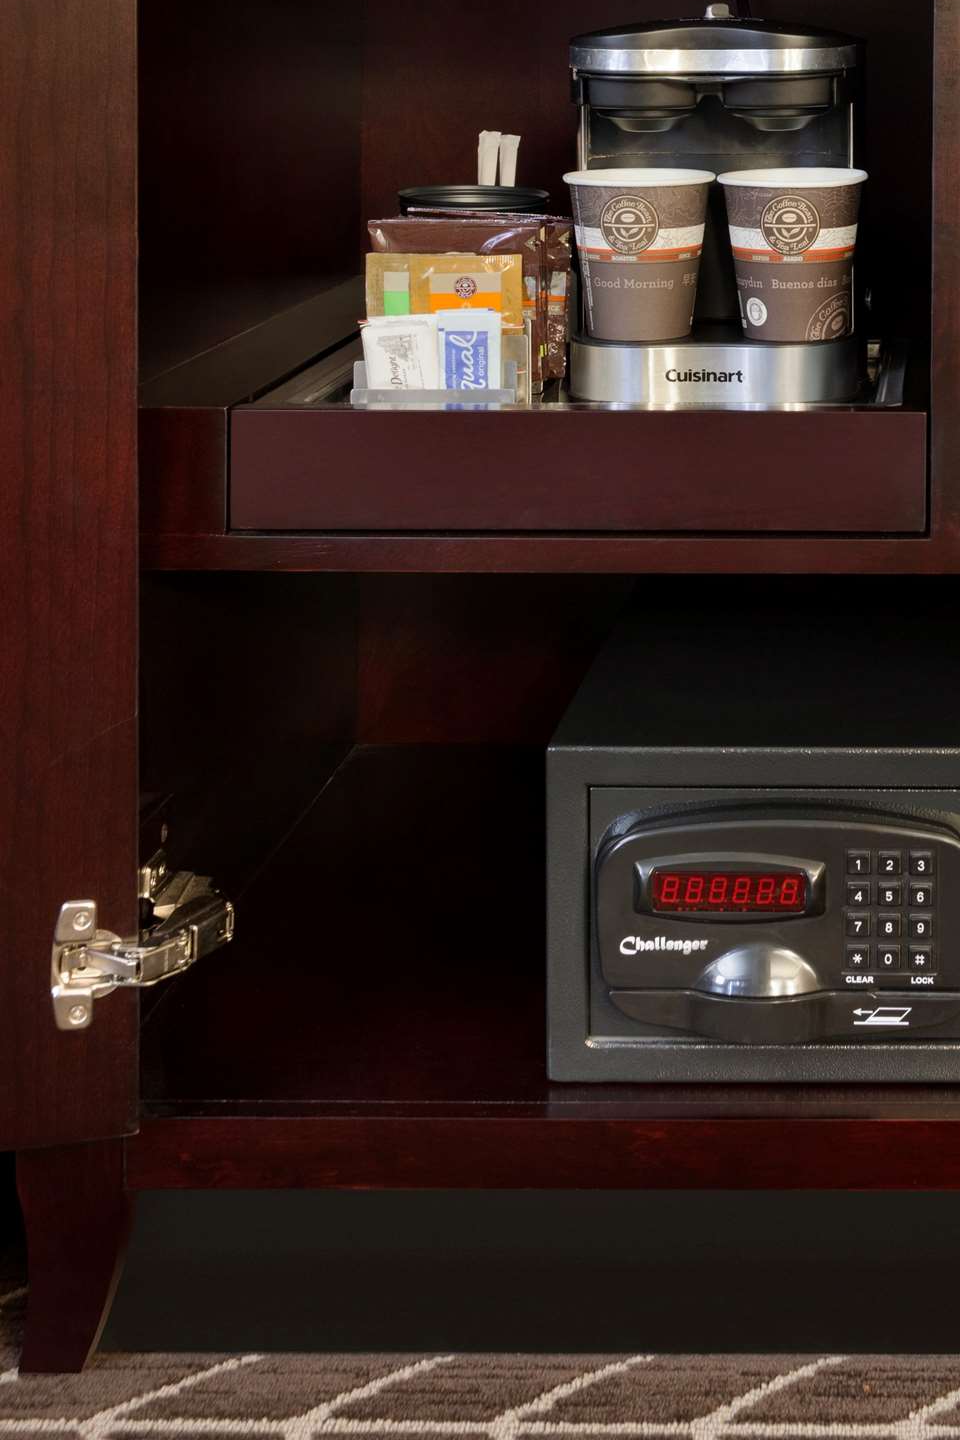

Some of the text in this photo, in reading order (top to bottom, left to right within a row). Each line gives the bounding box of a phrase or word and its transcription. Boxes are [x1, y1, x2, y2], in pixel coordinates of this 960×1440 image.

[593, 277, 674, 290] Good Morning
[771, 278, 814, 289] Buenos
[478, 346, 487, 377] original
[665, 368, 744, 383] Cuisinart
[855, 859, 925, 871] 1 2 3
[854, 891, 924, 903] 4 5 6
[854, 921, 925, 933] 7 8 9
[620, 935, 709, 955] Challenger
[884, 954, 892, 965] 0
[915, 954, 925, 965] #
[845, 976, 874, 984] CLEAR
